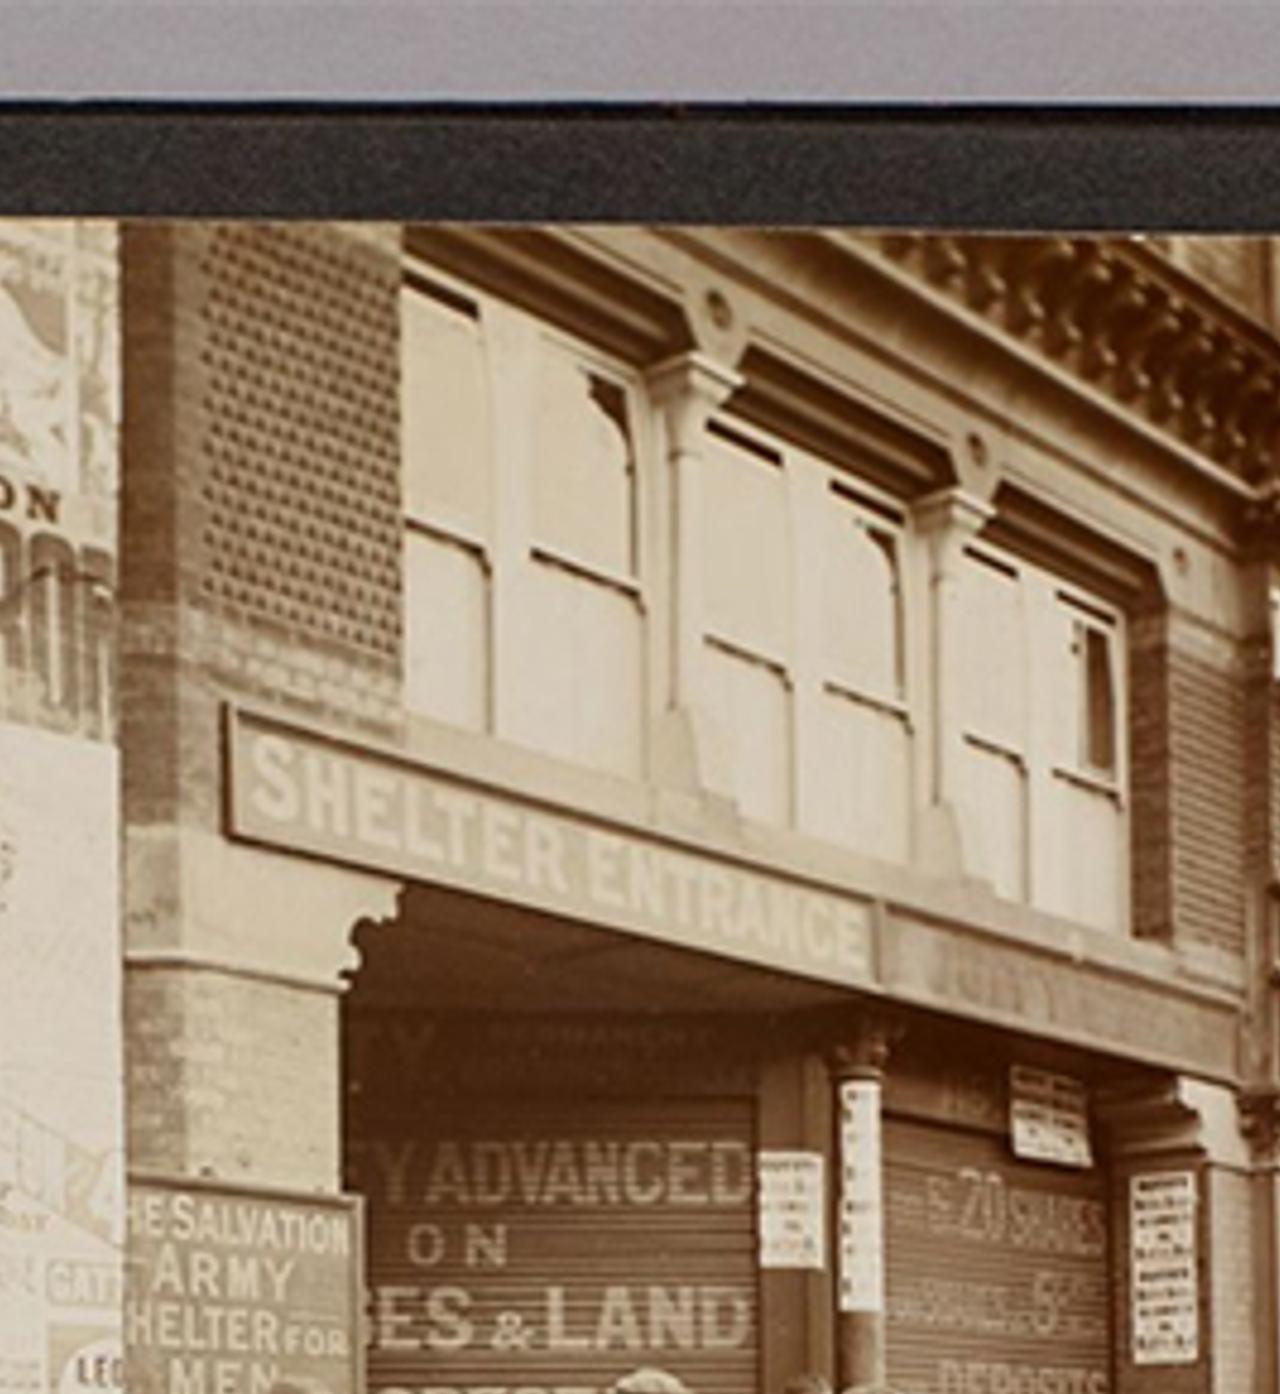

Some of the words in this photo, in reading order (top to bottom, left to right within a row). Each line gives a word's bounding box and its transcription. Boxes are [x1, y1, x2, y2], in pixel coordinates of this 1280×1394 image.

[252, 734, 568, 894] SHELTER
[590, 840, 867, 970] ENTRANCE
[428, 1140, 754, 1206] ADVANCED
[171, 1194, 352, 1258] SALVATION
[407, 1223, 509, 1268] ON
[145, 1242, 296, 1301] ARMY
[123, 1300, 280, 1354] HELTER
[284, 1324, 351, 1356] FOR
[376, 1284, 473, 1351] ES
[490, 1310, 535, 1350] &
[545, 1283, 753, 1351] LAND
